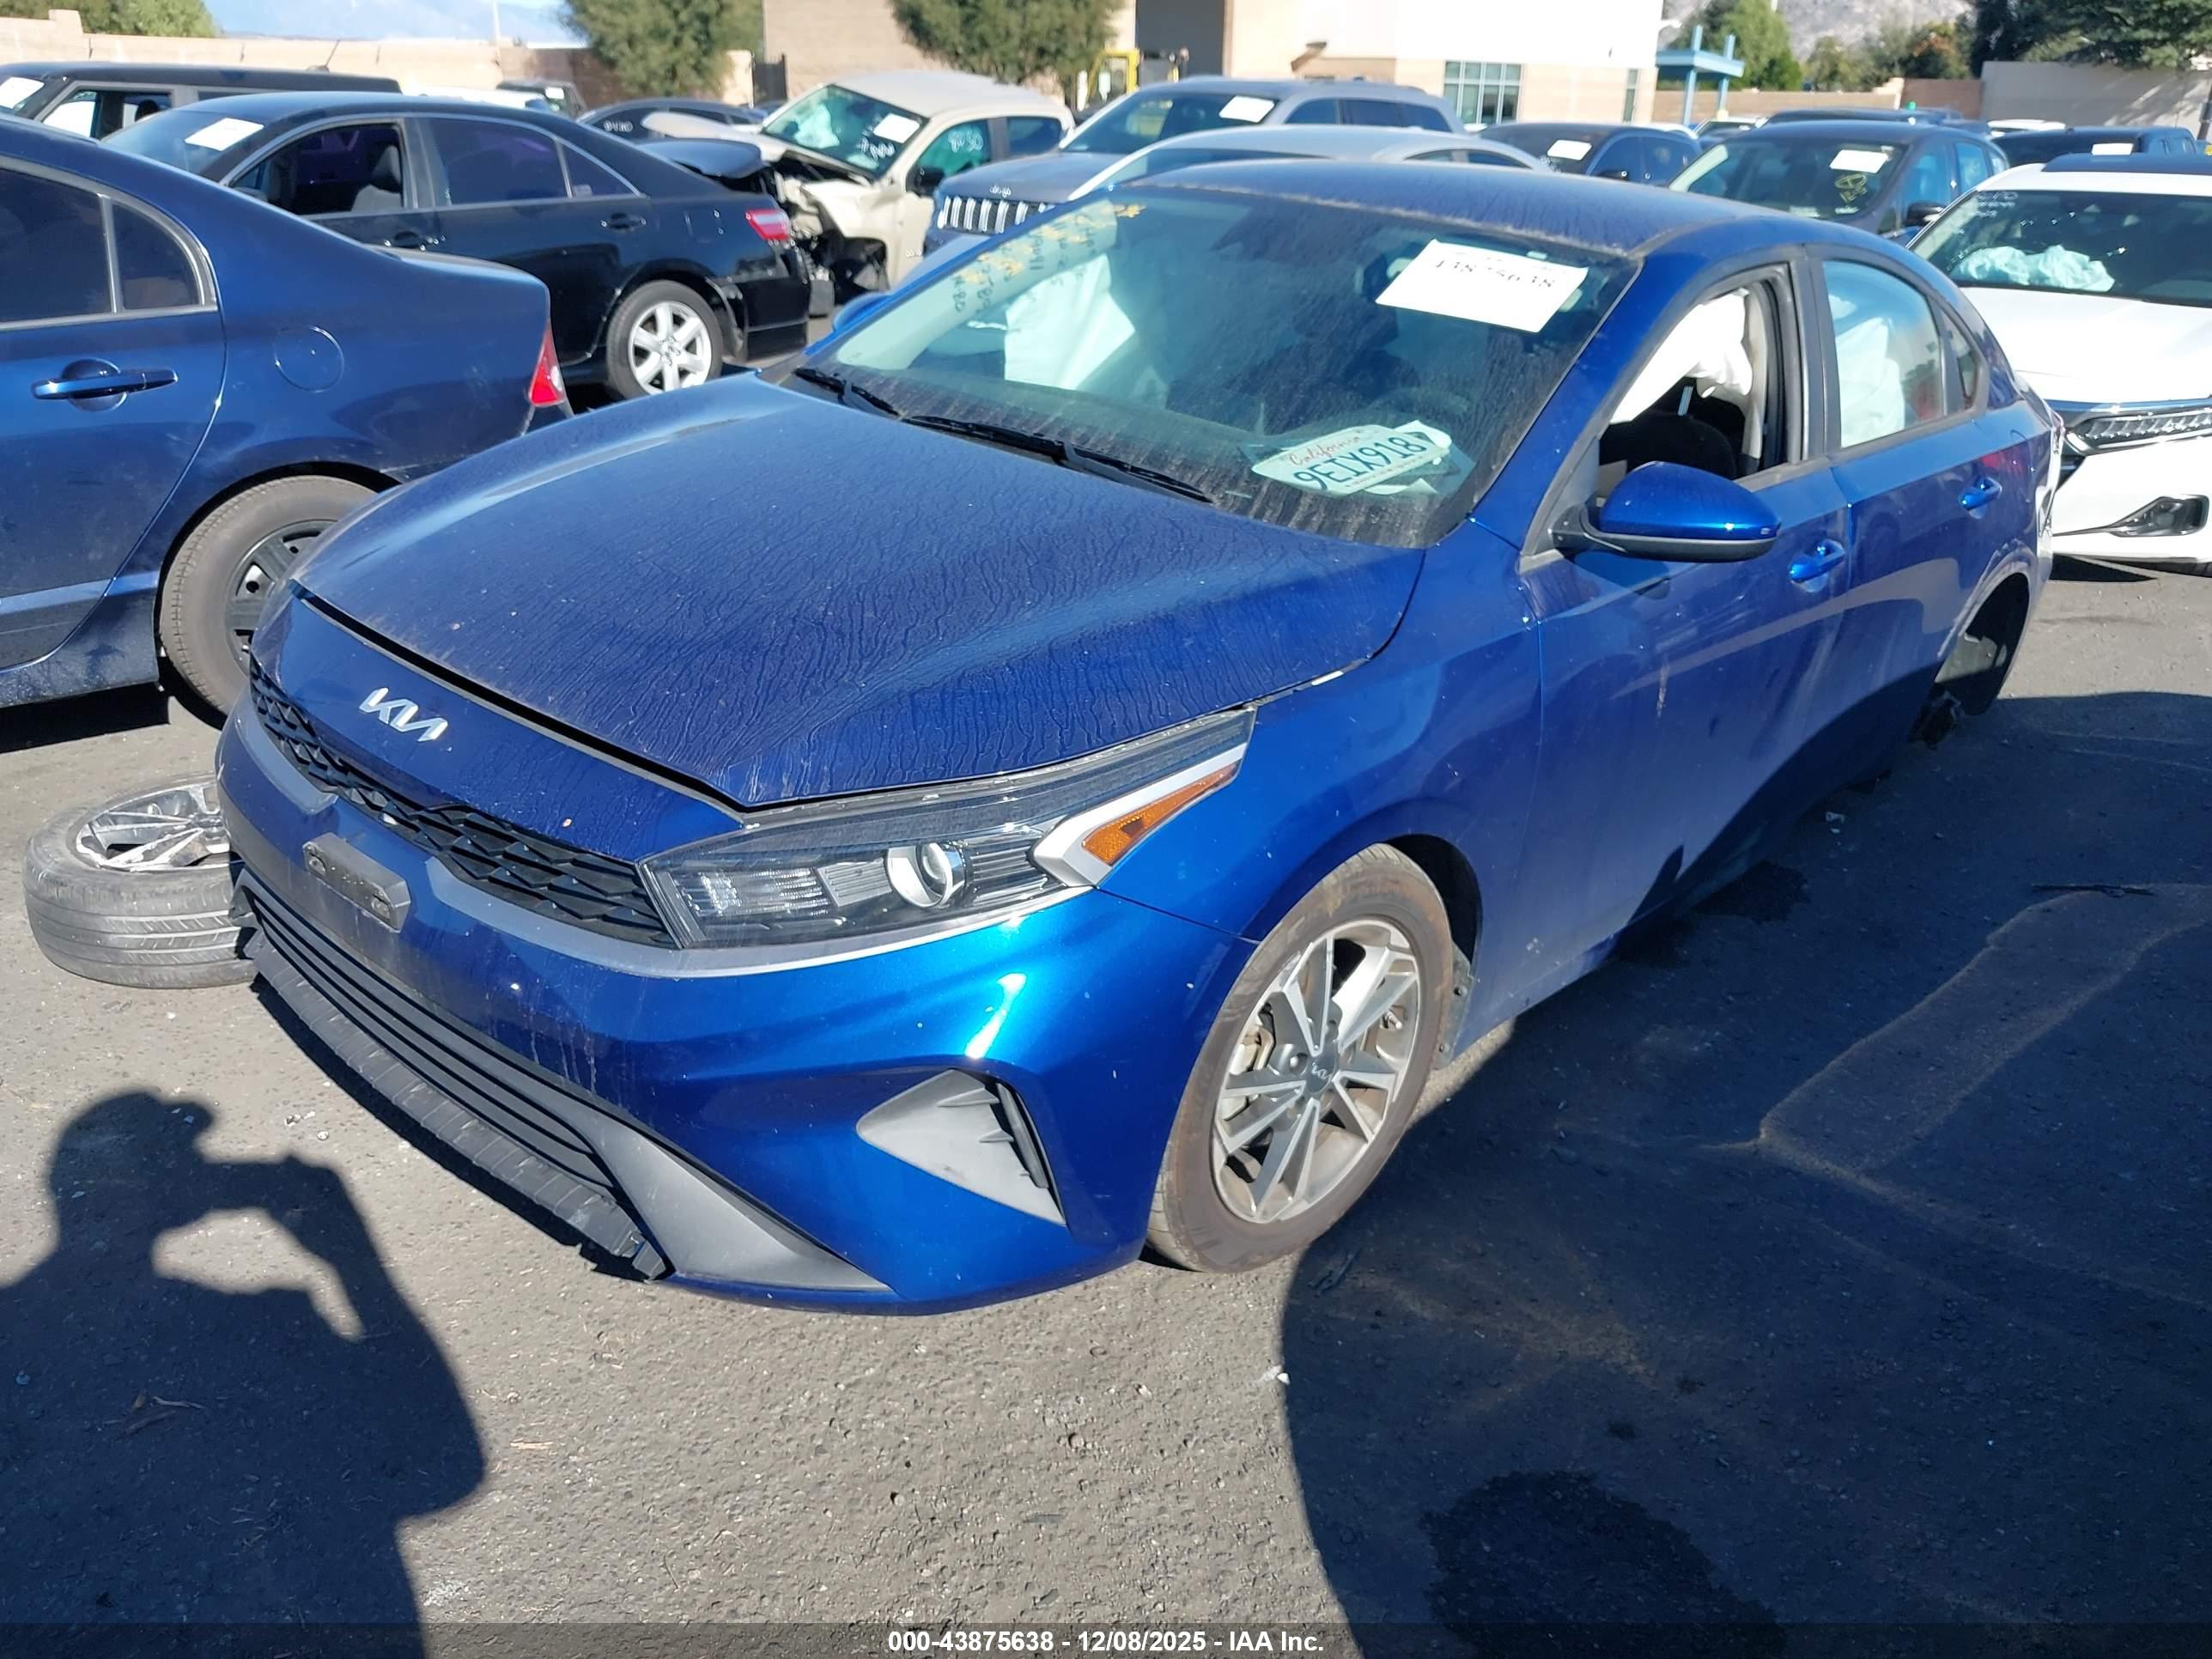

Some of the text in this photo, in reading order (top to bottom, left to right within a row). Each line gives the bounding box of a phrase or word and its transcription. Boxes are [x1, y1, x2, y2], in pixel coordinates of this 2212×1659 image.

[1289, 435, 1361, 466] California
[1293, 436, 1427, 491] 9EIX918
[359, 687, 448, 742] KIA
